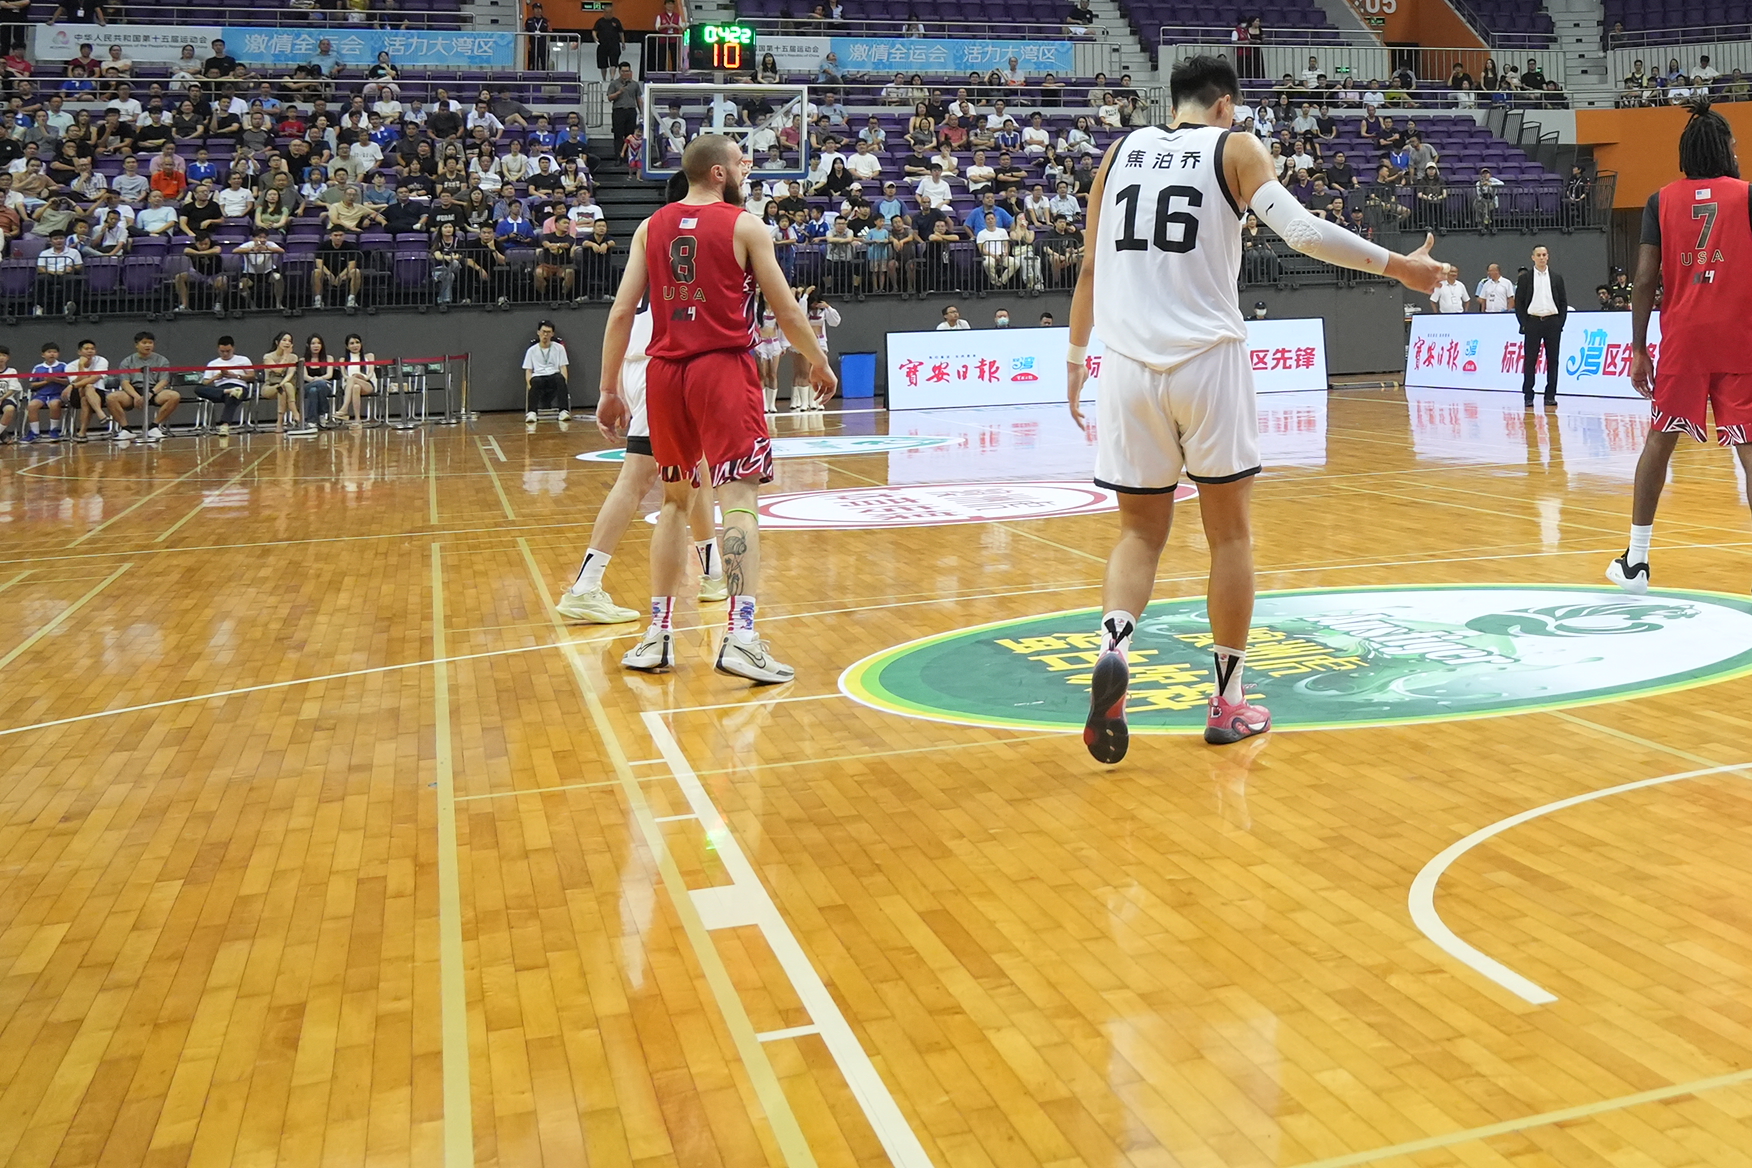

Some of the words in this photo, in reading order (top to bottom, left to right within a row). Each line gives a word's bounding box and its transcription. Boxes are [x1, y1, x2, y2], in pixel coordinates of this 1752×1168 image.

[384, 36, 494, 56] 活力大湾区
[713, 42, 740, 68] 10
[848, 44, 947, 64] 激情全运会
[962, 44, 1056, 64] 活力大湾区
[1124, 150, 1202, 170] 焦泊乔
[1114, 184, 1204, 254] 16
[1692, 202, 1718, 250] 7
[668, 235, 698, 284] 8
[1681, 248, 1724, 266] USA
[662, 286, 706, 302] USA
[1250, 346, 1316, 370] 区先锋
